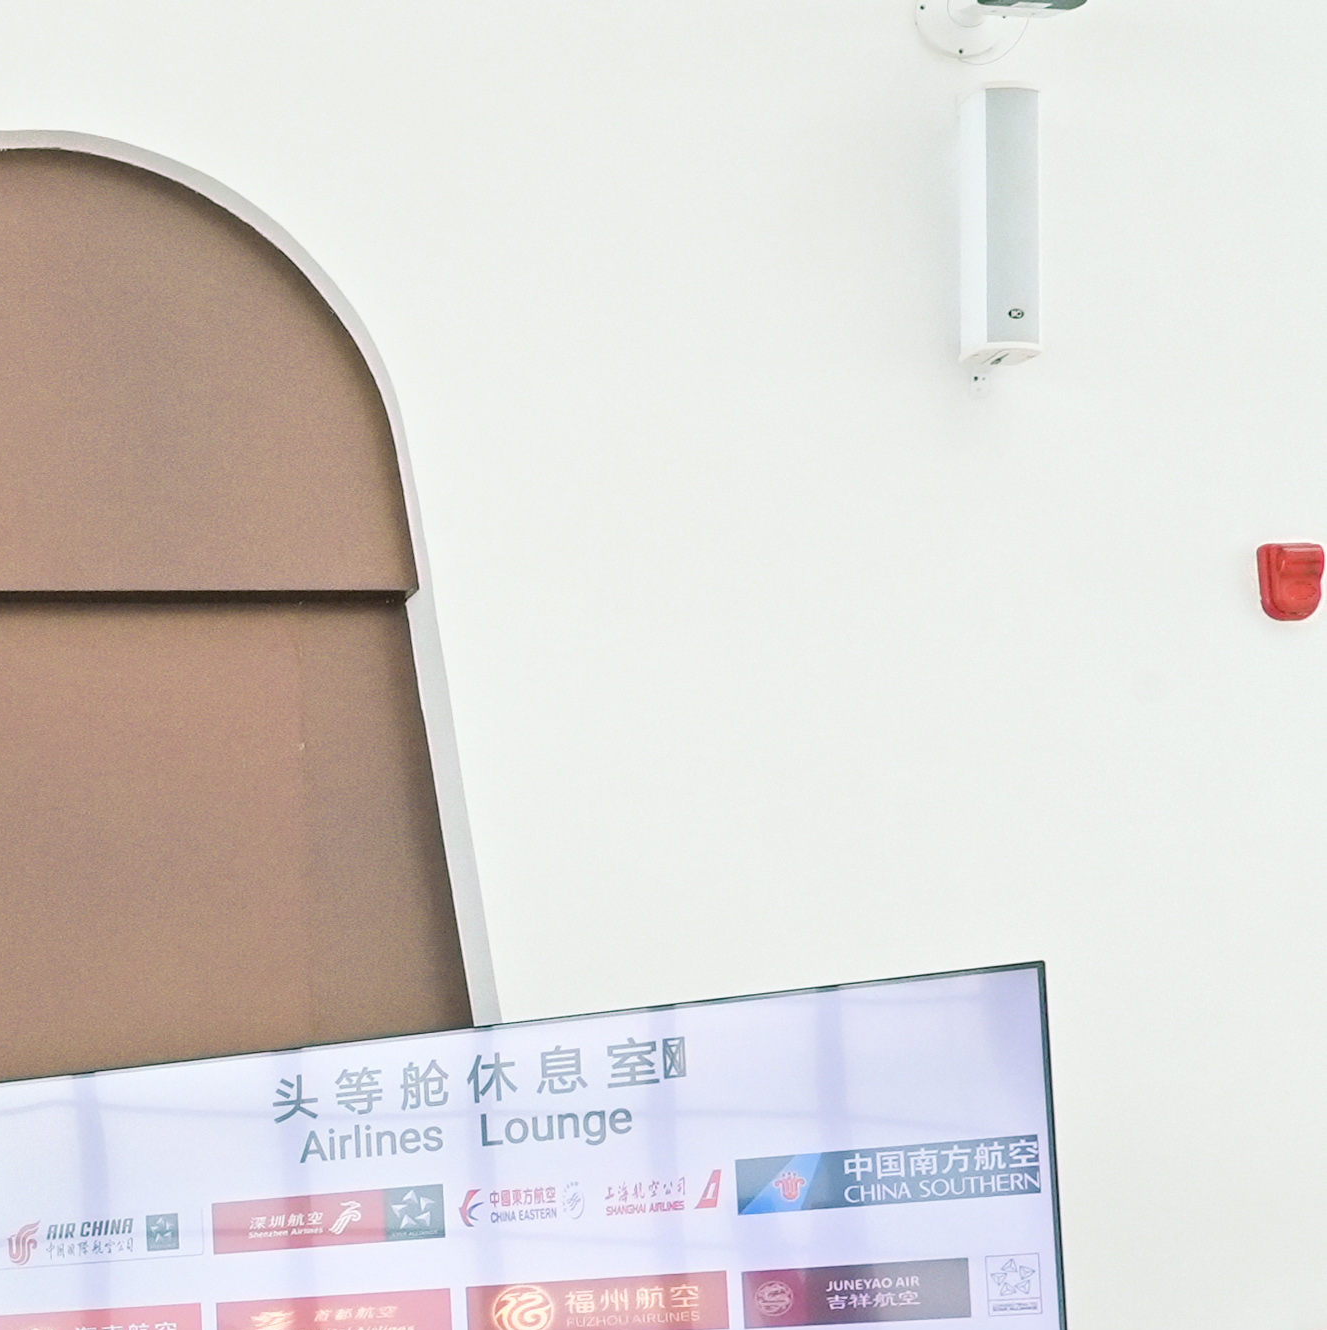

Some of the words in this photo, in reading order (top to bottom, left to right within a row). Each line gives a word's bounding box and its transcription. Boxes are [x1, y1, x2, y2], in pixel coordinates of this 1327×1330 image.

[273, 1037, 660, 1124] 头等舱休息室
[300, 1124, 444, 1164] Airlines
[480, 1107, 633, 1147] Lounge
[843, 1139, 1040, 1182] 中国南方航空
[843, 1183, 912, 1204] CHINA
[918, 1170, 1042, 1199] SOUTHERN
[490, 1209, 516, 1224] CHINA
[518, 1207, 558, 1222] EASTERN
[605, 1203, 647, 1217] SHANGHAI
[648, 1200, 685, 1213] AIRLINES
[47, 1223, 76, 1241] AIR
[79, 1217, 134, 1239] CHINA
[248, 1210, 324, 1231] 深圳航空
[248, 1229, 289, 1240] Shenzhen
[290, 1226, 324, 1237] Airlines
[825, 1277, 892, 1293] JUNEYAO
[895, 1275, 920, 1288] AIR
[564, 1283, 700, 1315] 福州航空
[826, 1290, 921, 1311] 吉祥航空
[313, 1304, 399, 1323] 首都航空
[565, 1313, 630, 1329] FUZHOU
[631, 1310, 701, 1323] AIRLINES
